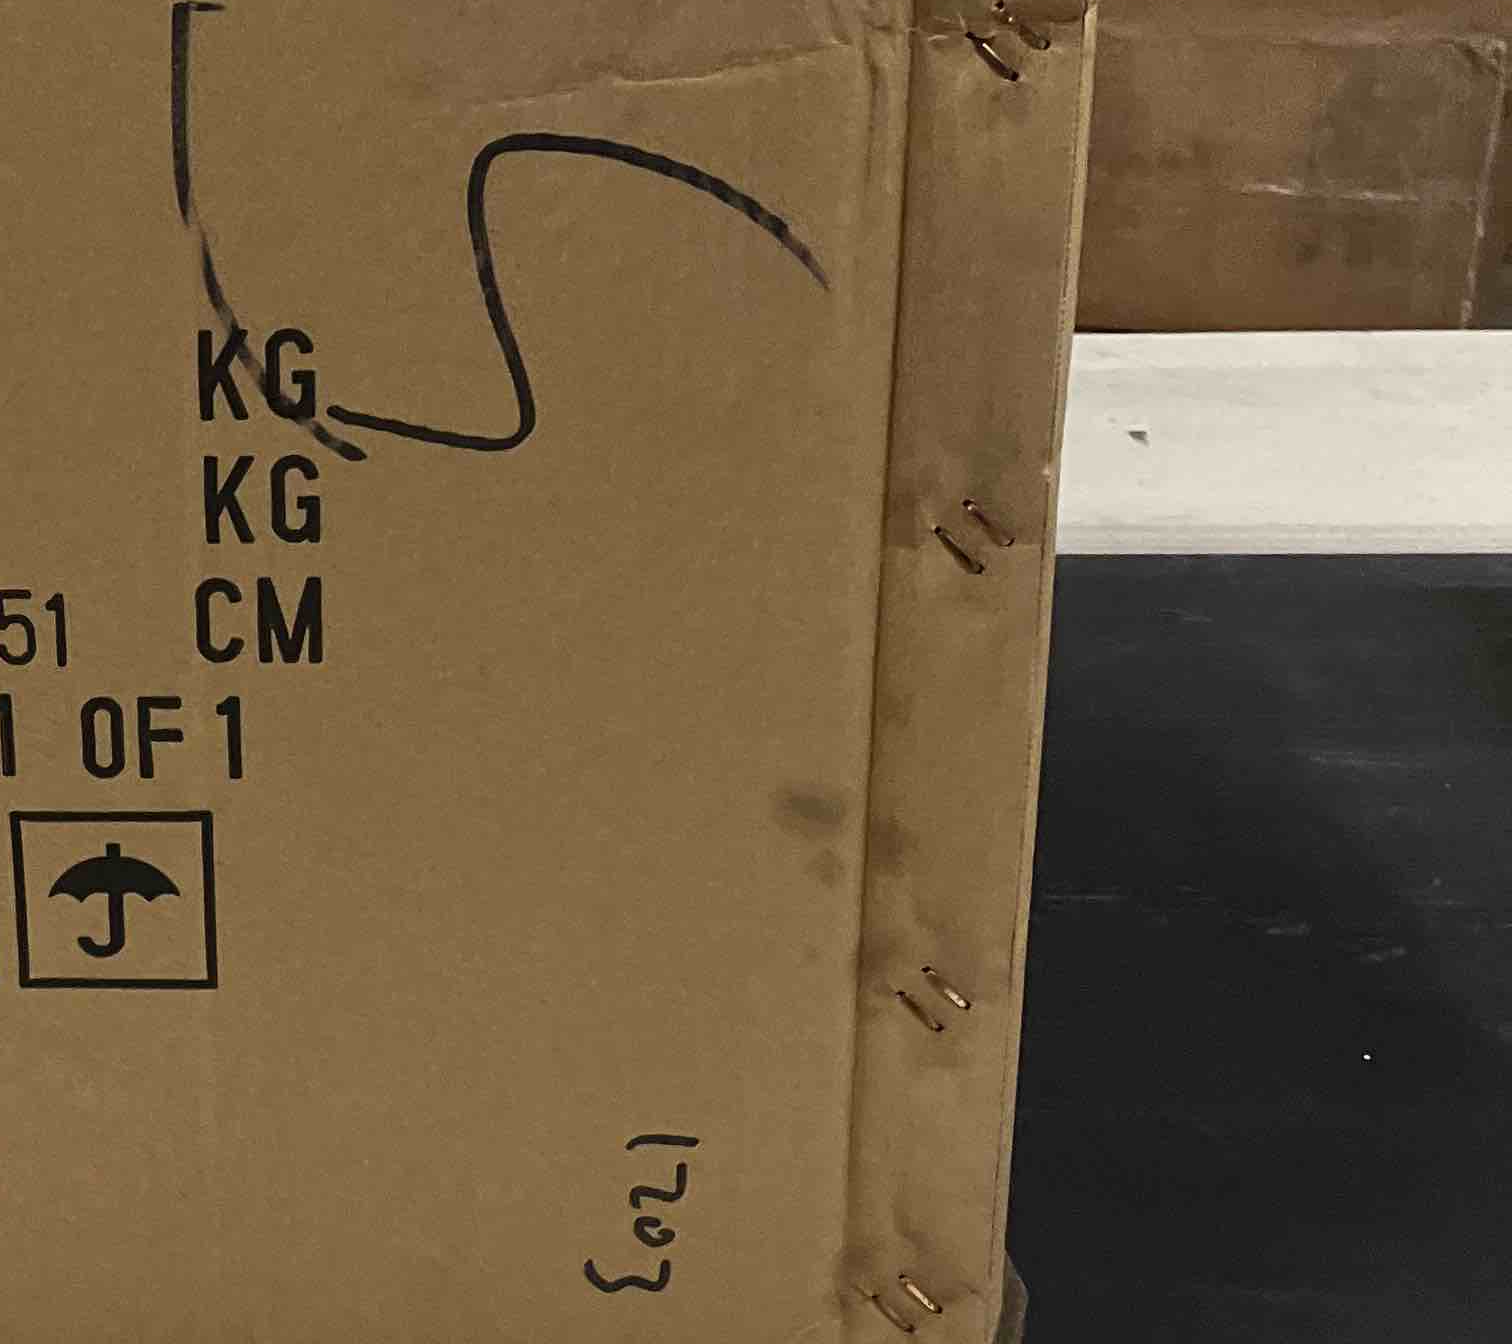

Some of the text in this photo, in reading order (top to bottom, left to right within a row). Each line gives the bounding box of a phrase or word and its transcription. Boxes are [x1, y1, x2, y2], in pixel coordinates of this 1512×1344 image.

[196, 328, 317, 422] KG
[202, 454, 322, 544] KG
[194, 576, 324, 664] CM
[80, 696, 184, 779] OF
[215, 695, 243, 779] 1
